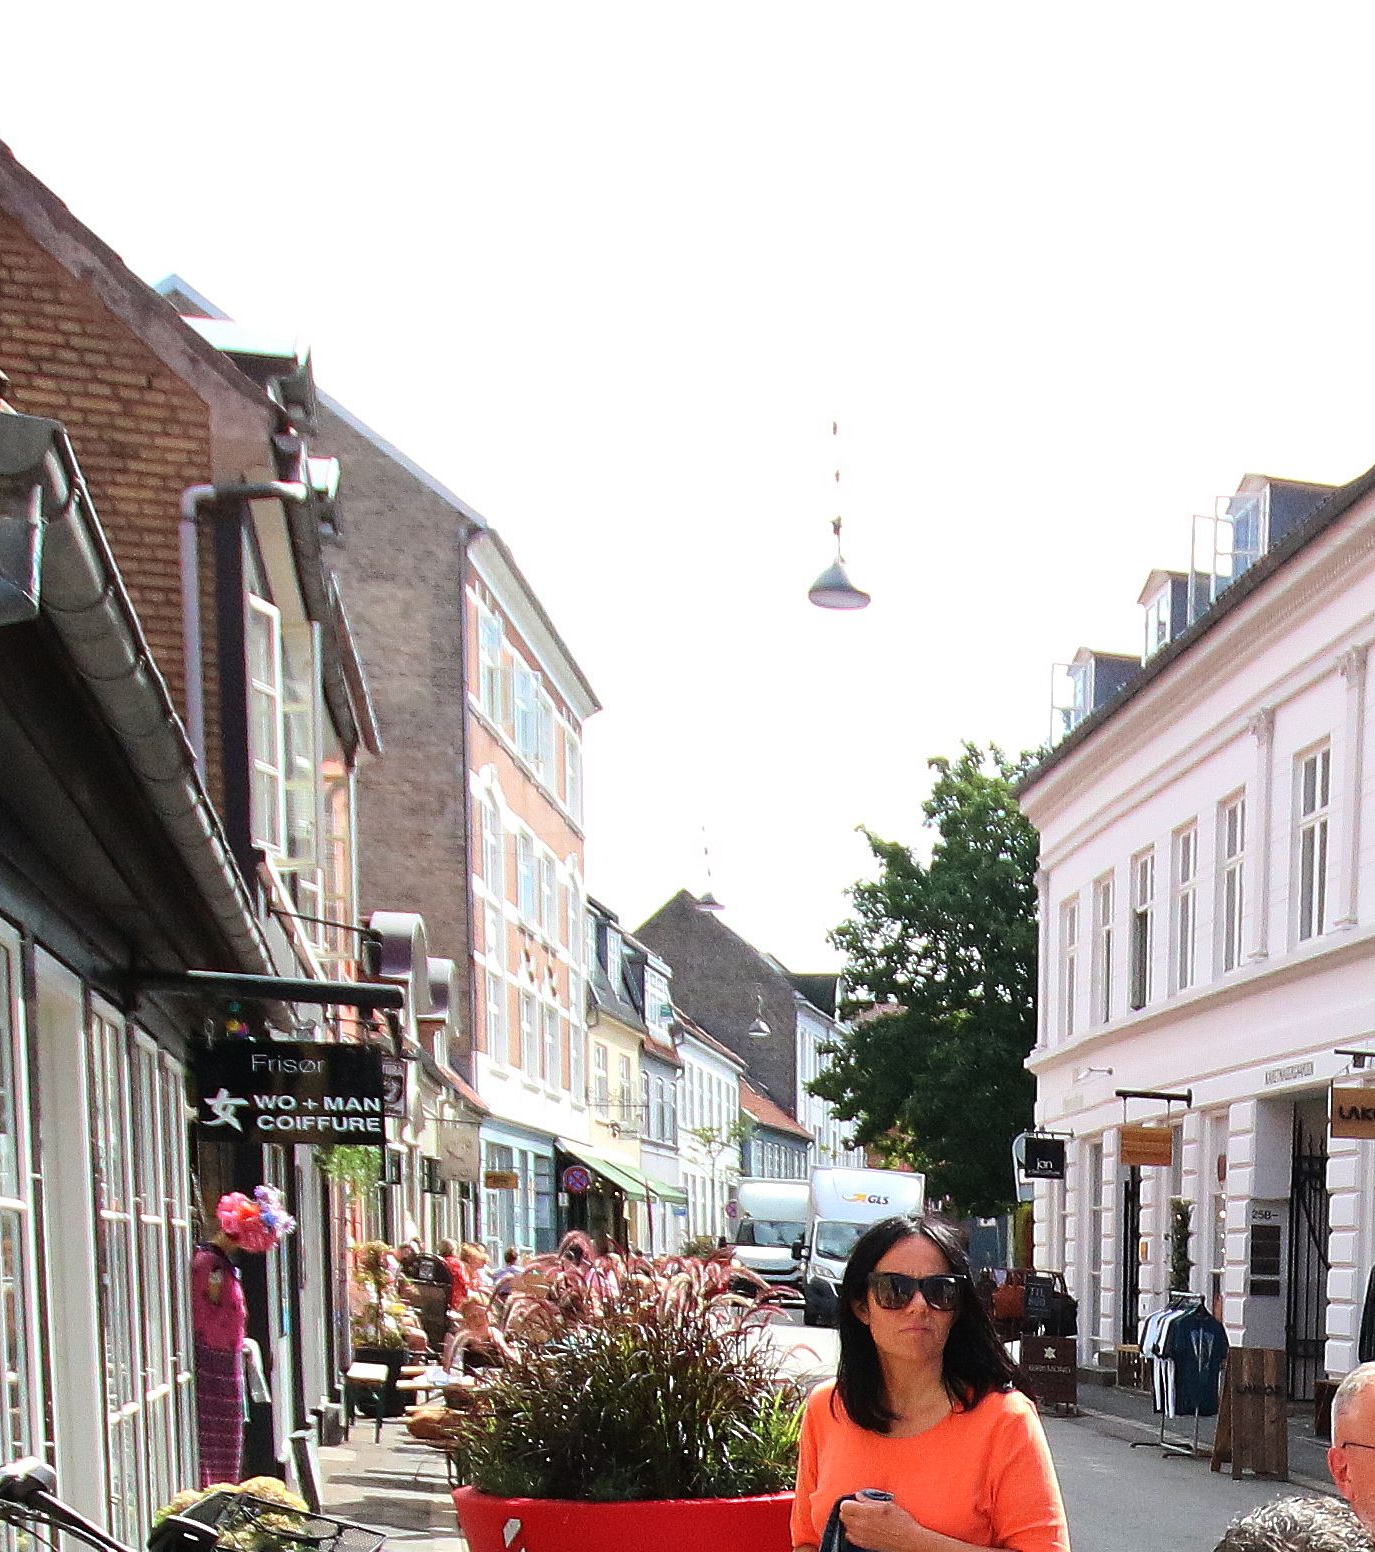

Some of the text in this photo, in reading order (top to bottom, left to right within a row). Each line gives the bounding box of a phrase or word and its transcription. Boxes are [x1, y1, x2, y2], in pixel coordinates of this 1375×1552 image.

[251, 1054, 326, 1073] Frisør
[253, 1095, 297, 1110] WO
[323, 1096, 382, 1112] MAN
[256, 1115, 382, 1132] COIFFURE
[867, 1194, 889, 1205] GLS
